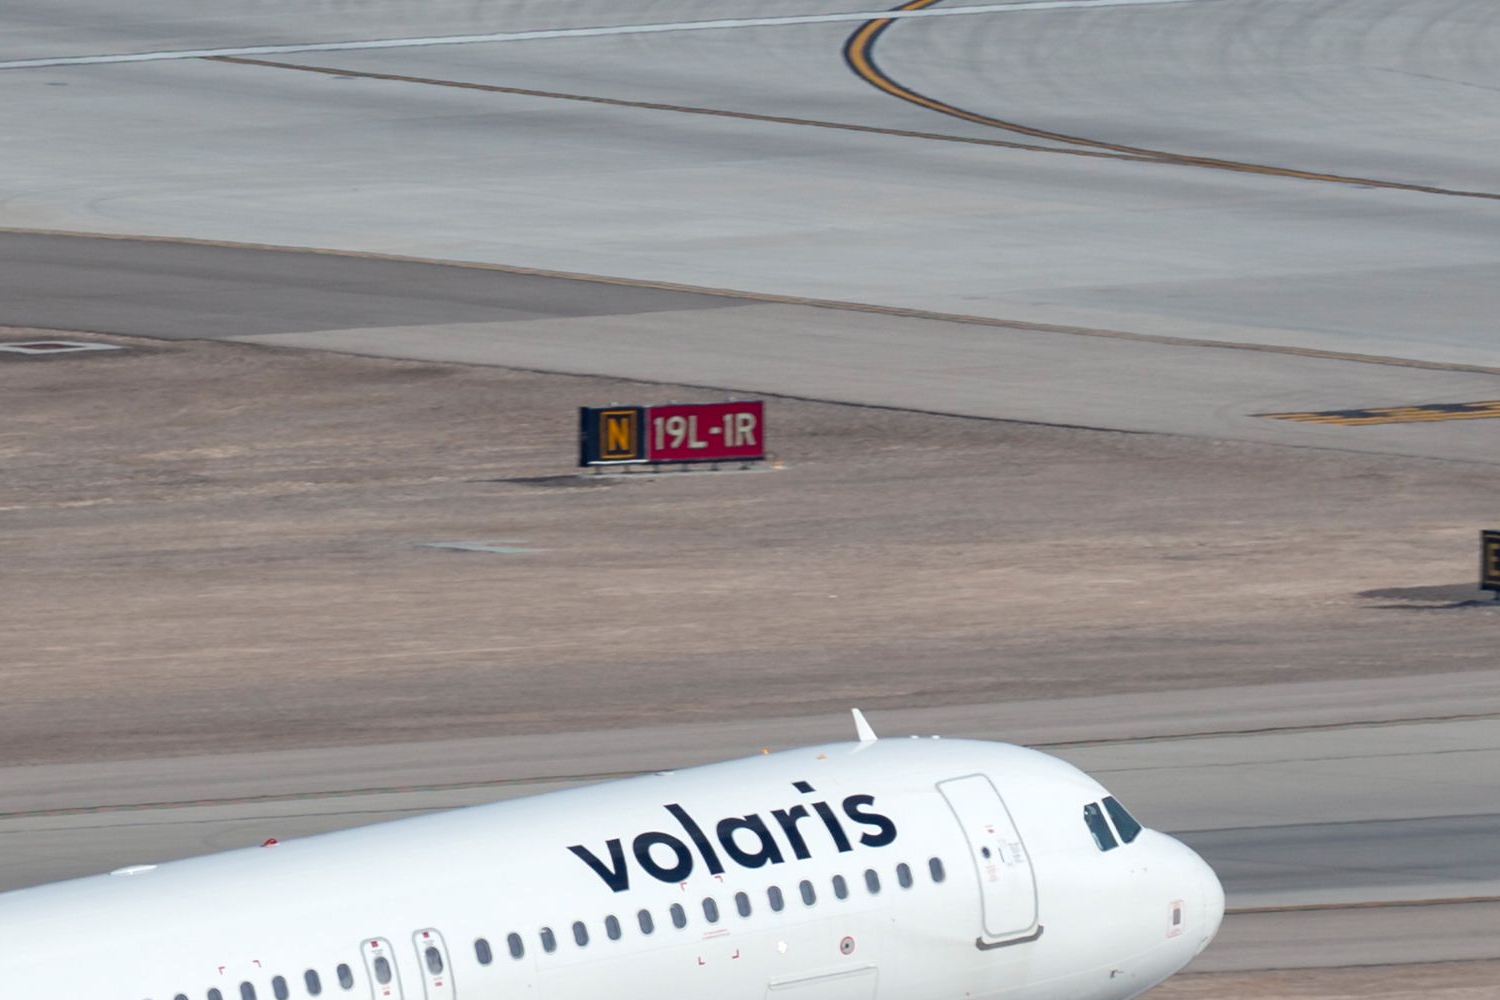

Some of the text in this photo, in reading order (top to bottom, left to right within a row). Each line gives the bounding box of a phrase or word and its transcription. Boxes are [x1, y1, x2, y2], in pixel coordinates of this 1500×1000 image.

[607, 417, 630, 451] N
[653, 412, 756, 450] 19L-1R
[566, 780, 898, 893] volaris
